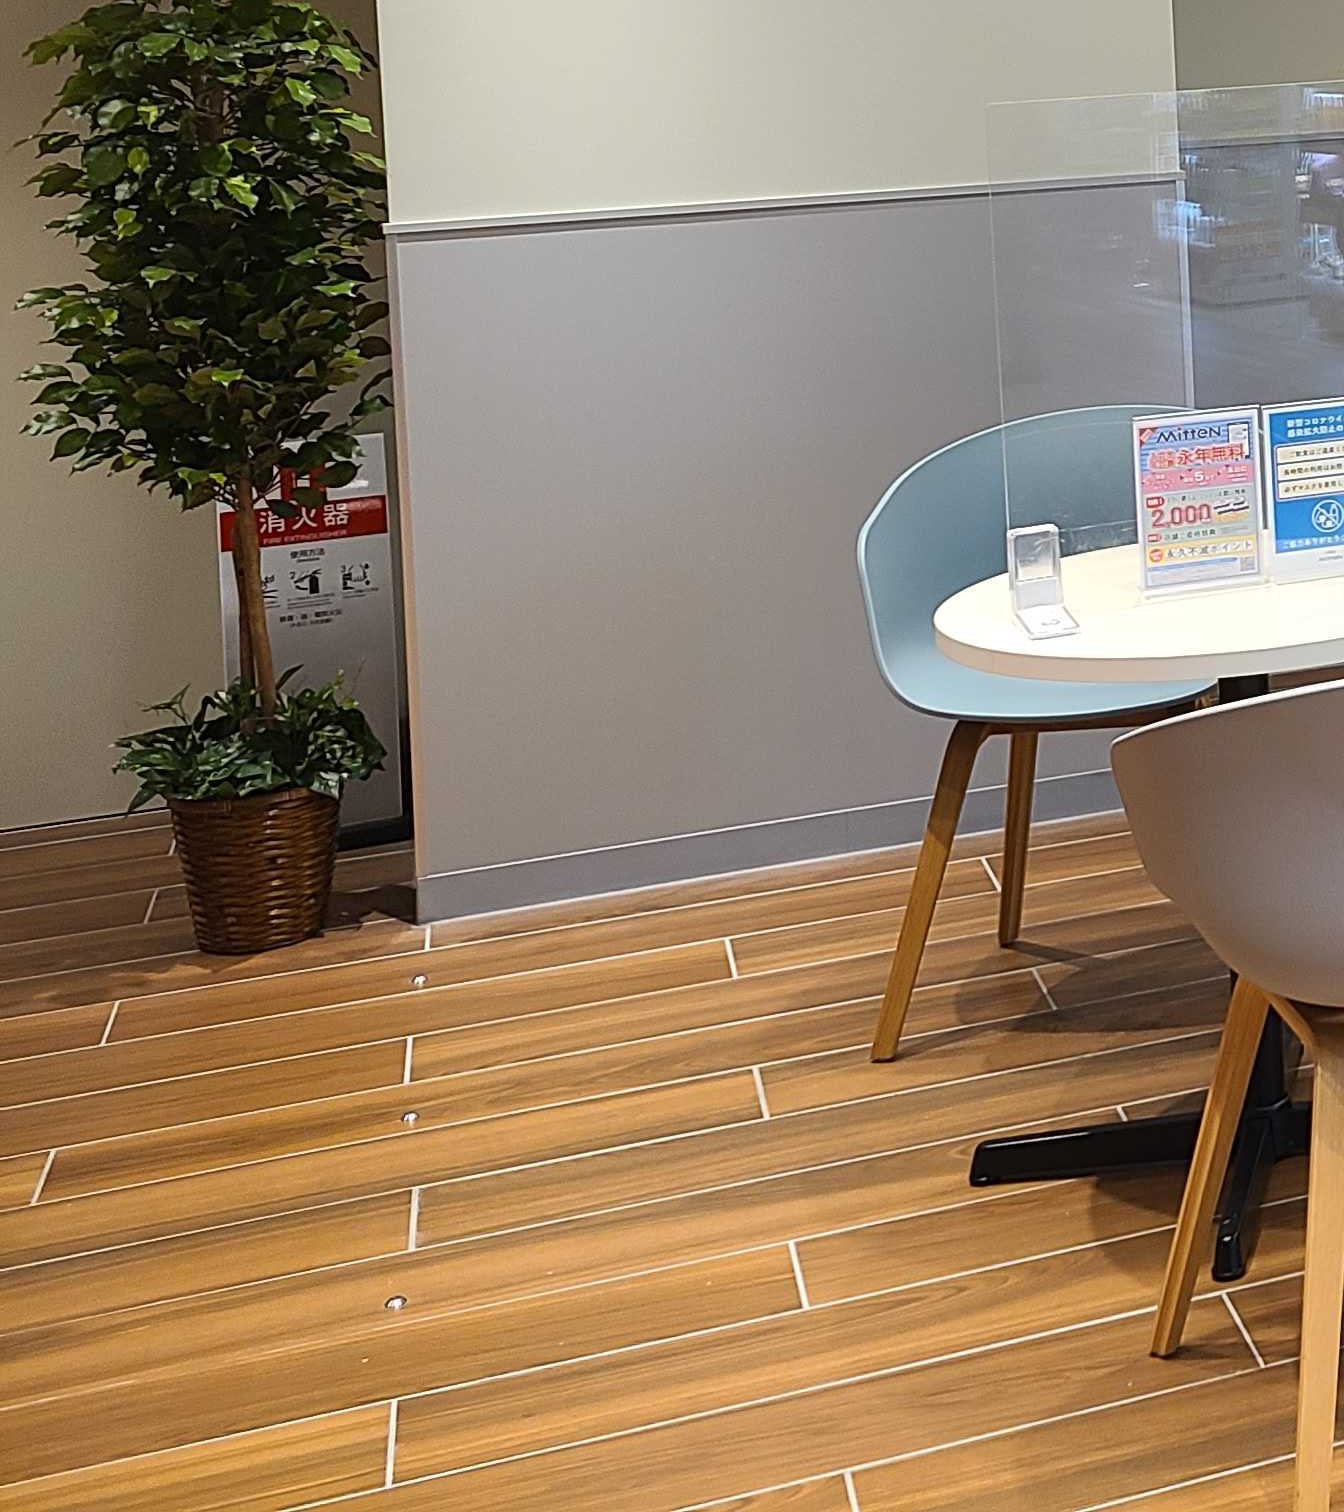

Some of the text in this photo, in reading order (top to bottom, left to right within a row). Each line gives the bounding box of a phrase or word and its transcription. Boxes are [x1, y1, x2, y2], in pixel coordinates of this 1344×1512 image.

[1156, 426, 1221, 444] MitteN
[259, 502, 350, 535] 消火器
